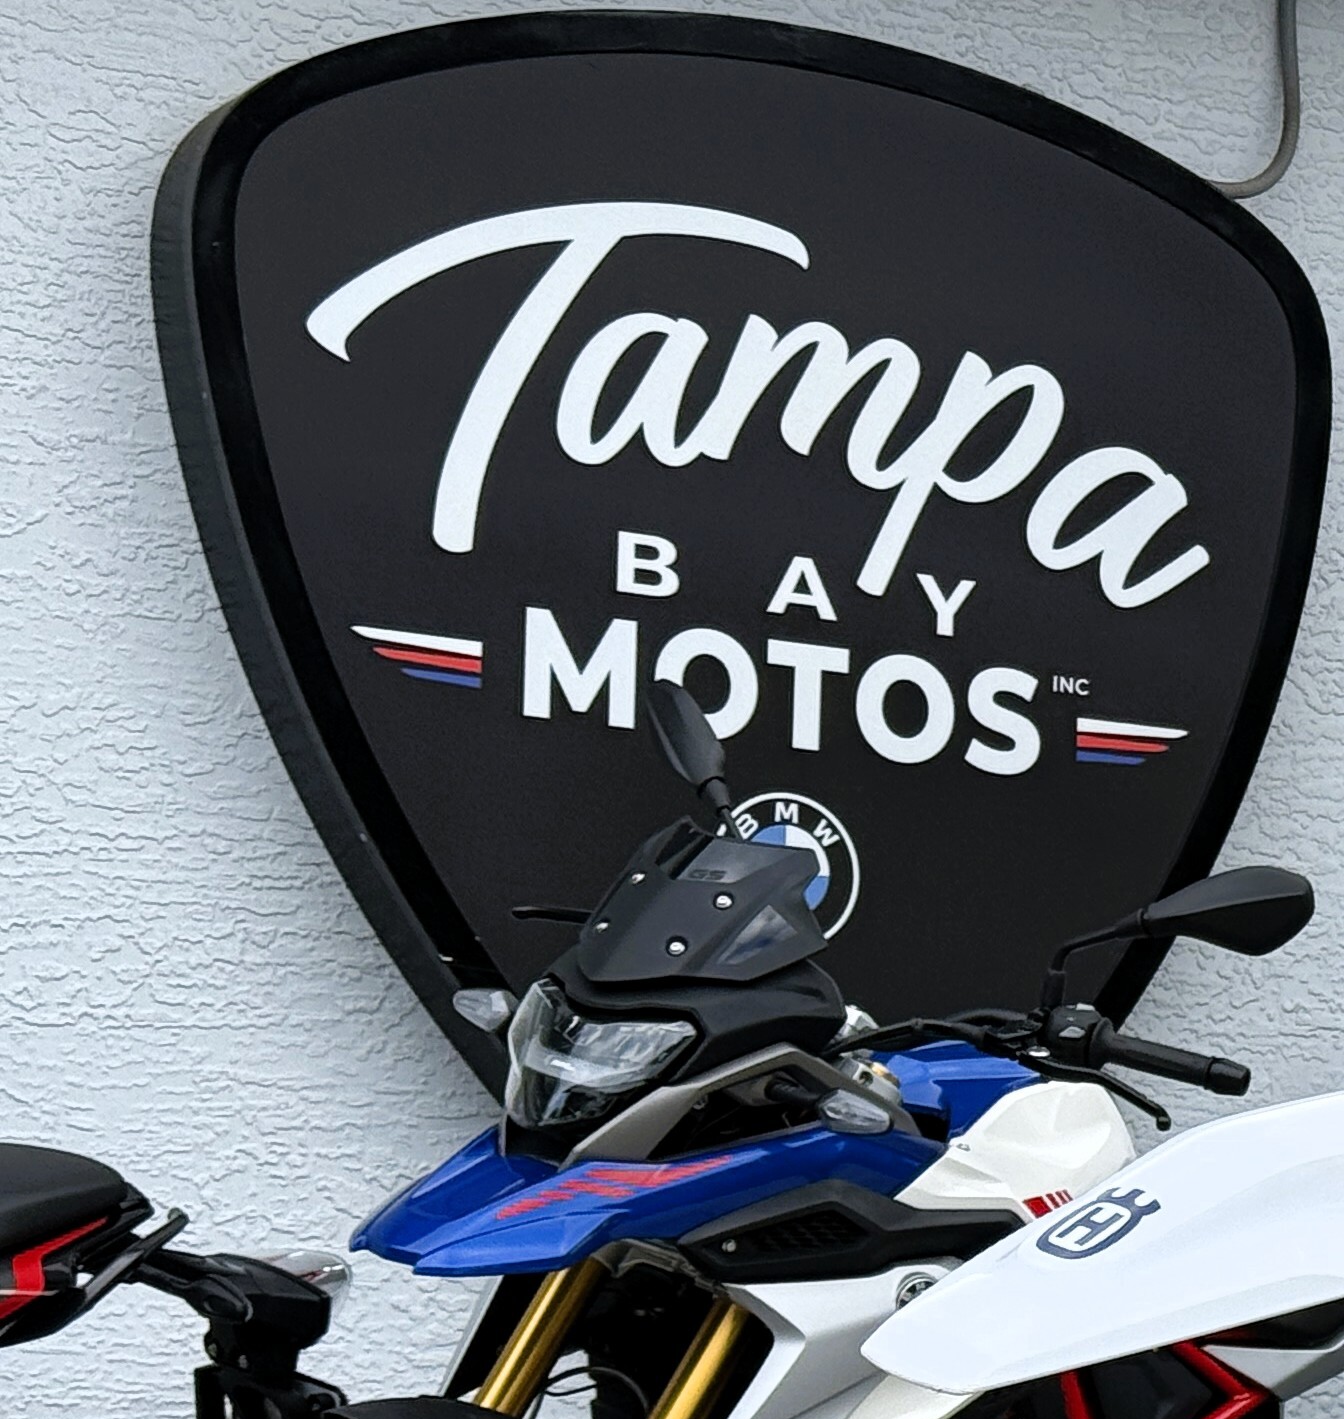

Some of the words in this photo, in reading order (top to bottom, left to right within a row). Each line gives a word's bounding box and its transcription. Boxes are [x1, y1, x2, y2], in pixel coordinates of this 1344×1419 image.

[306, 201, 1210, 609] Tampa
[615, 530, 976, 636] BAY
[522, 606, 1039, 775] MOTOS
[1053, 675, 1089, 696] INC
[735, 802, 840, 847] BMW
